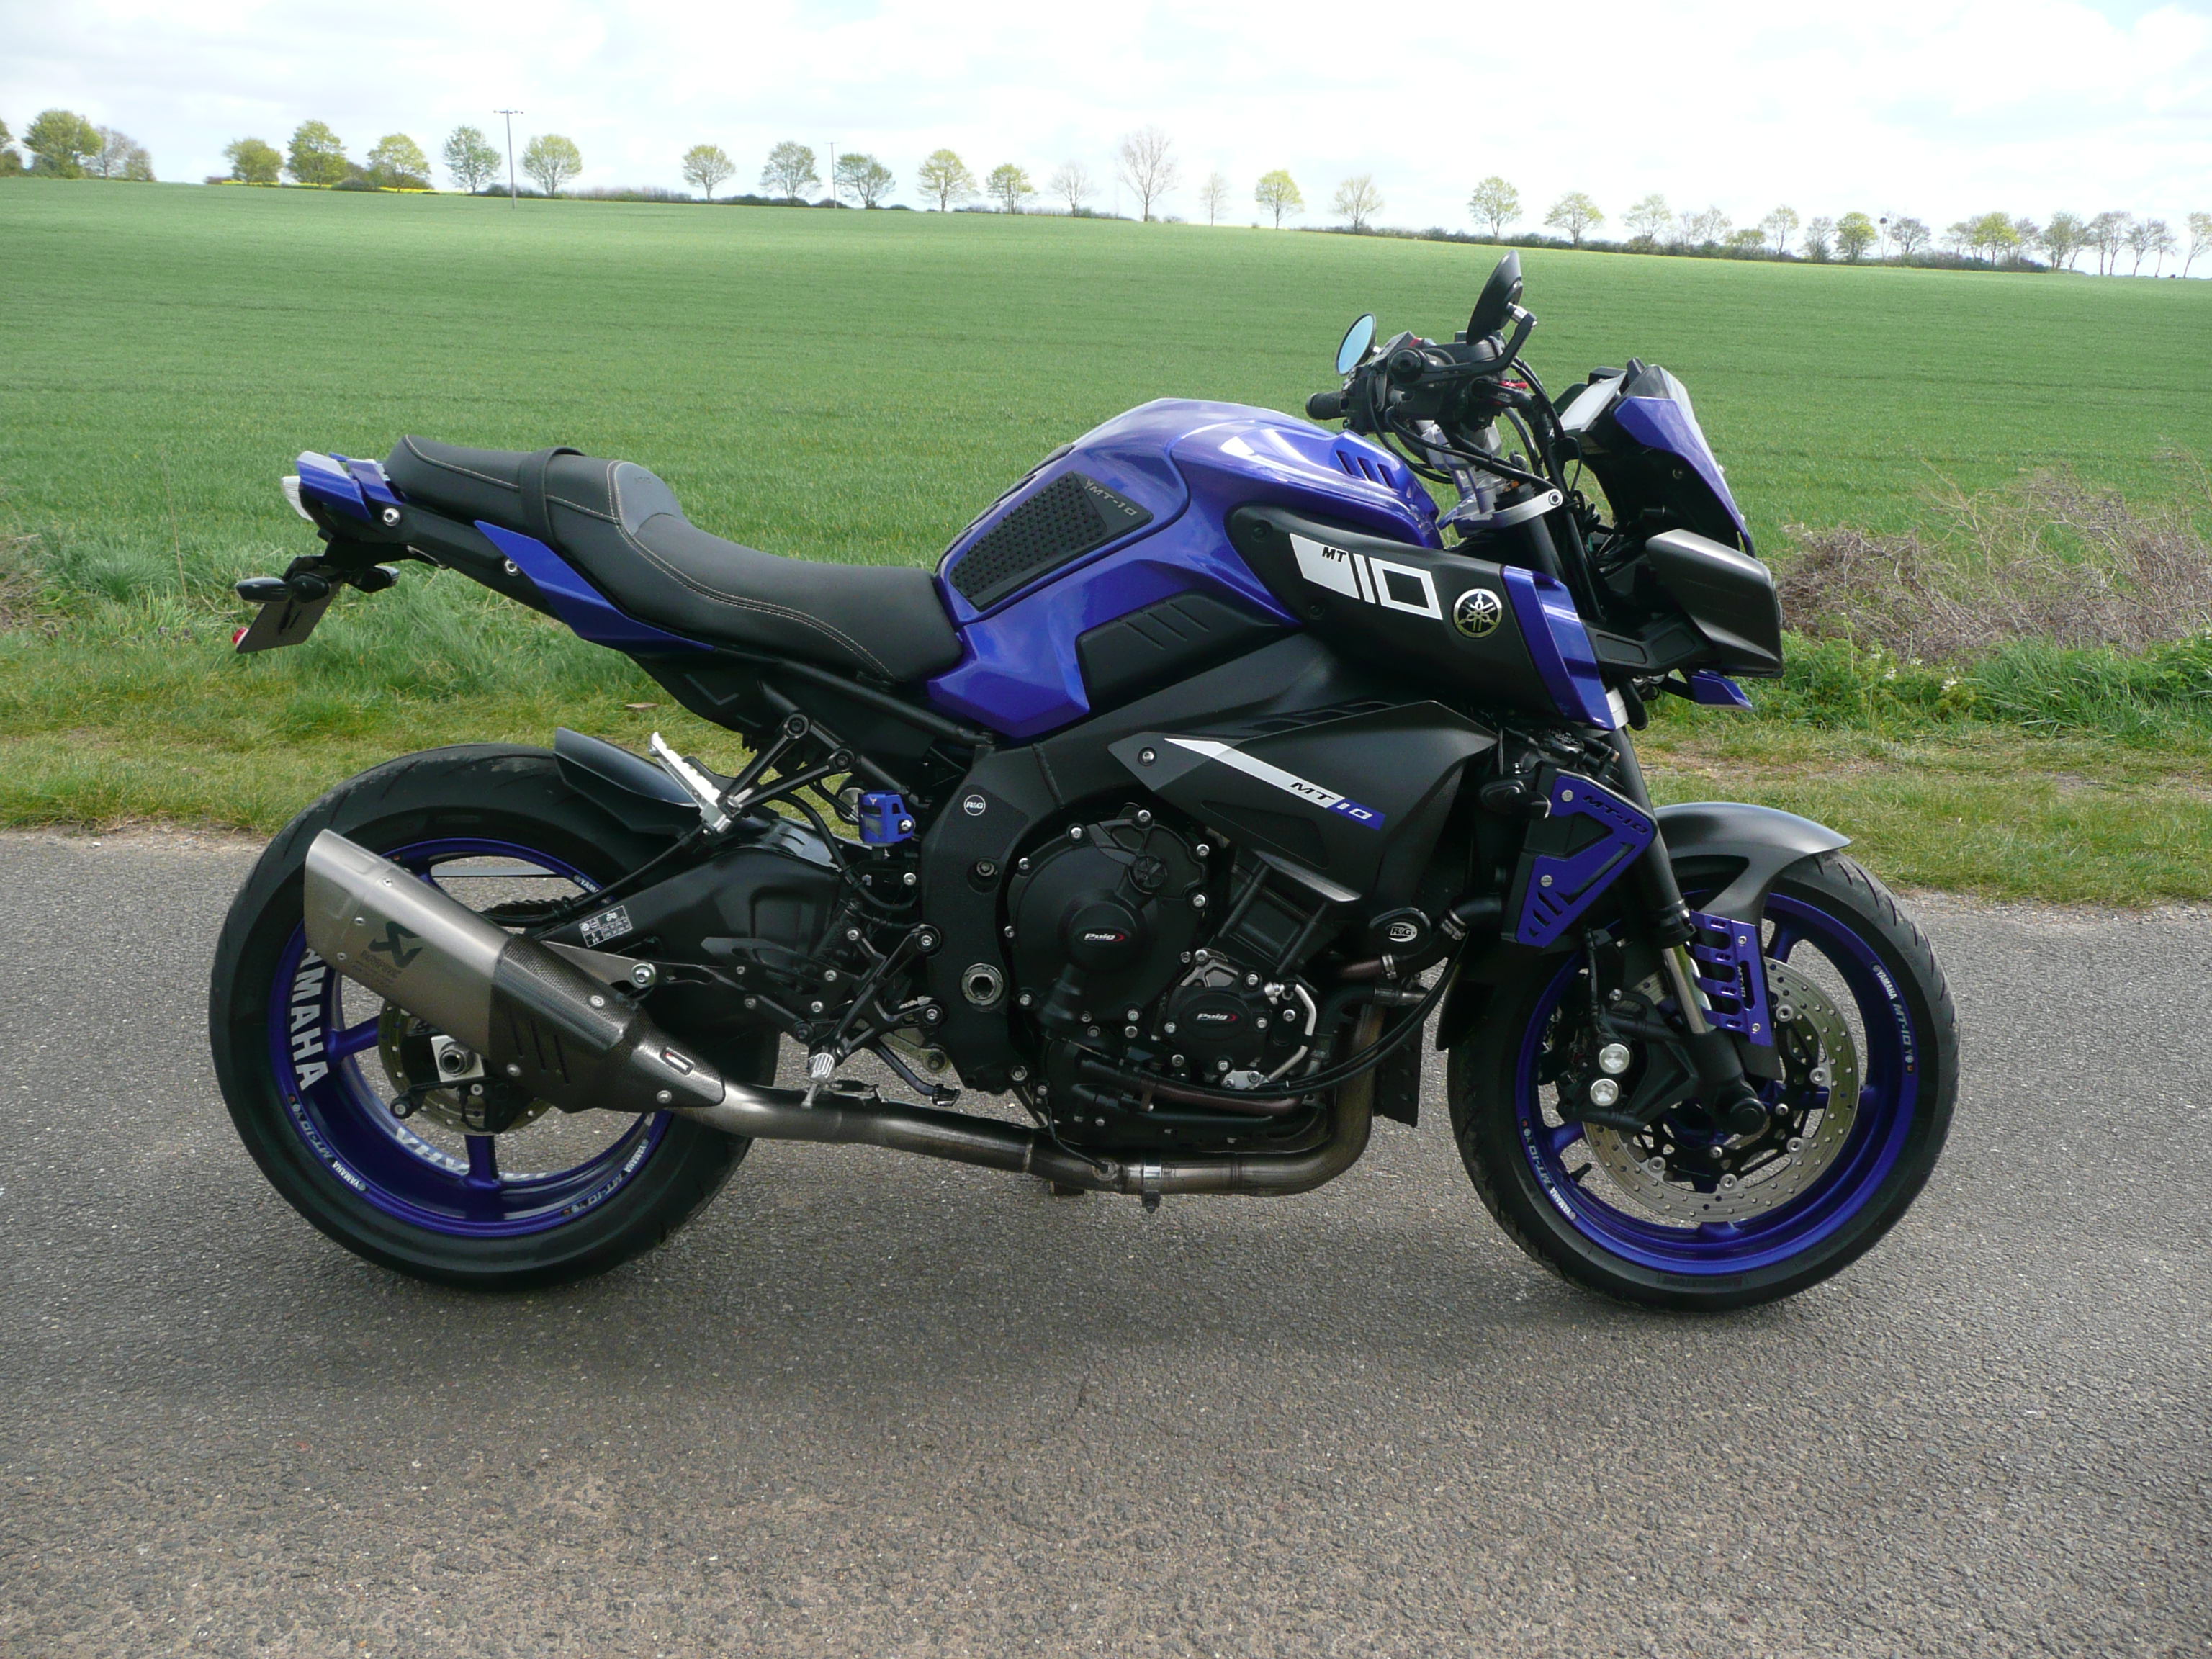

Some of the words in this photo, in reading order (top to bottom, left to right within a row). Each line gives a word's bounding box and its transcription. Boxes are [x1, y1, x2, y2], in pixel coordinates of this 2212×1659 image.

[1322, 547, 1346, 562] MT
[1583, 795, 1649, 834] MT-10
[1390, 926, 1412, 936] R&G
[1876, 969, 1898, 1000] YAMAHA
[290, 947, 329, 1091] AMAHA
[623, 1145, 647, 1173] YAMAHA
[331, 1160, 359, 1188] YAMAHA
[1550, 1187, 1572, 1216] YAMAHA
